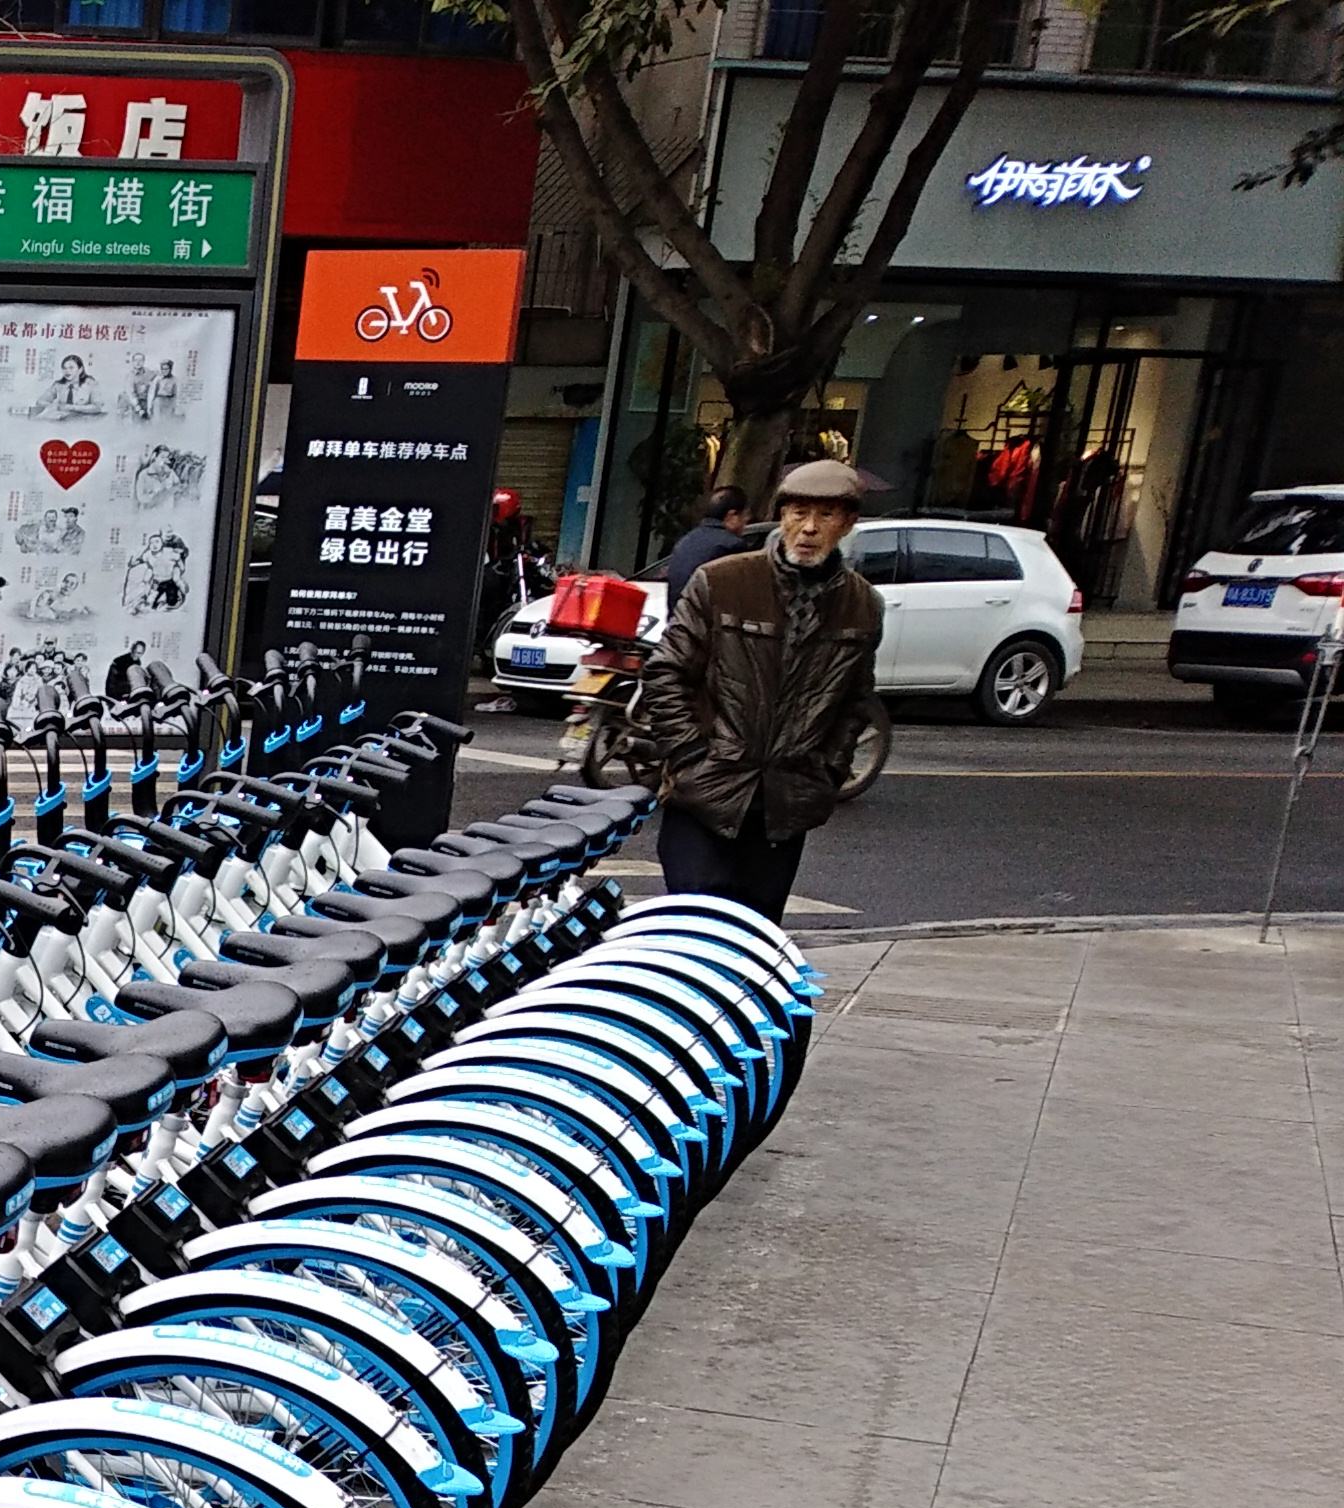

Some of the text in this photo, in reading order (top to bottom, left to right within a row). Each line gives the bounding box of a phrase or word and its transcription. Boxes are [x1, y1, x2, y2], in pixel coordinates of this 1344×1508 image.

[20, 238, 151, 256] Xingfu Side streets
[172, 239, 193, 260] 南
[306, 439, 469, 461] 摩拜单车推荐停车点
[324, 505, 433, 534] 富美金堂
[319, 537, 429, 567] 绿色出行
